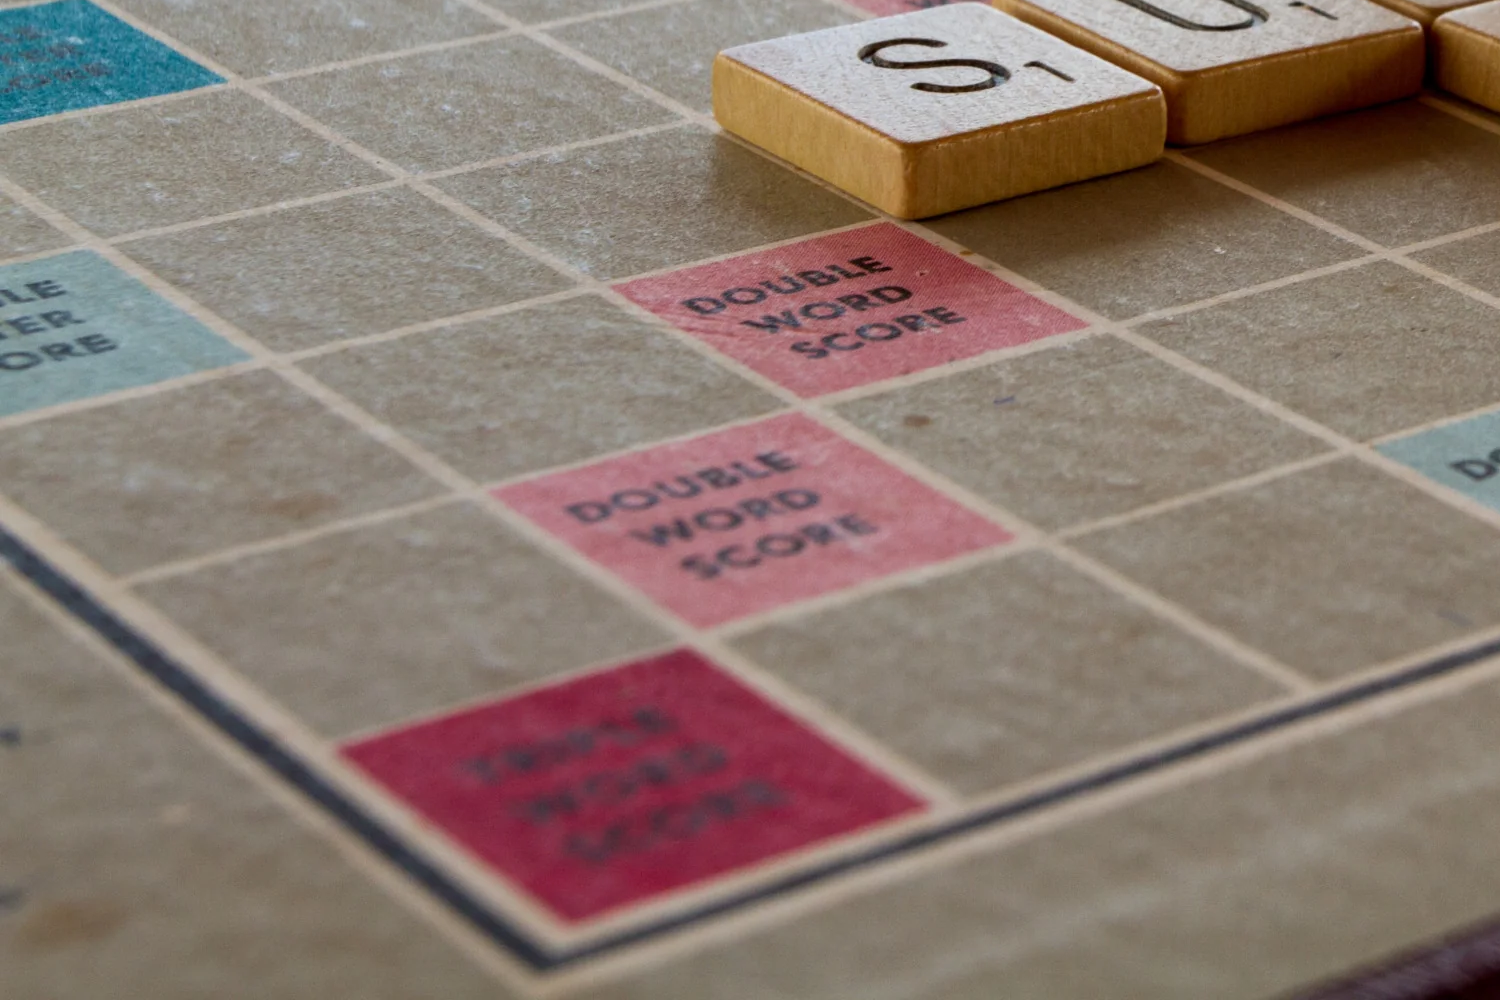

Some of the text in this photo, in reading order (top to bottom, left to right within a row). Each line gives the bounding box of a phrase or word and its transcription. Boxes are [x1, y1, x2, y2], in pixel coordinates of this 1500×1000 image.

[856, 36, 1012, 94] S
[681, 256, 893, 315] DOUBLE
[740, 285, 913, 334] WORD
[789, 306, 967, 360] SCORE
[563, 450, 799, 525] DOUBLE
[629, 487, 822, 547] WORD
[680, 512, 880, 581] SCORE
